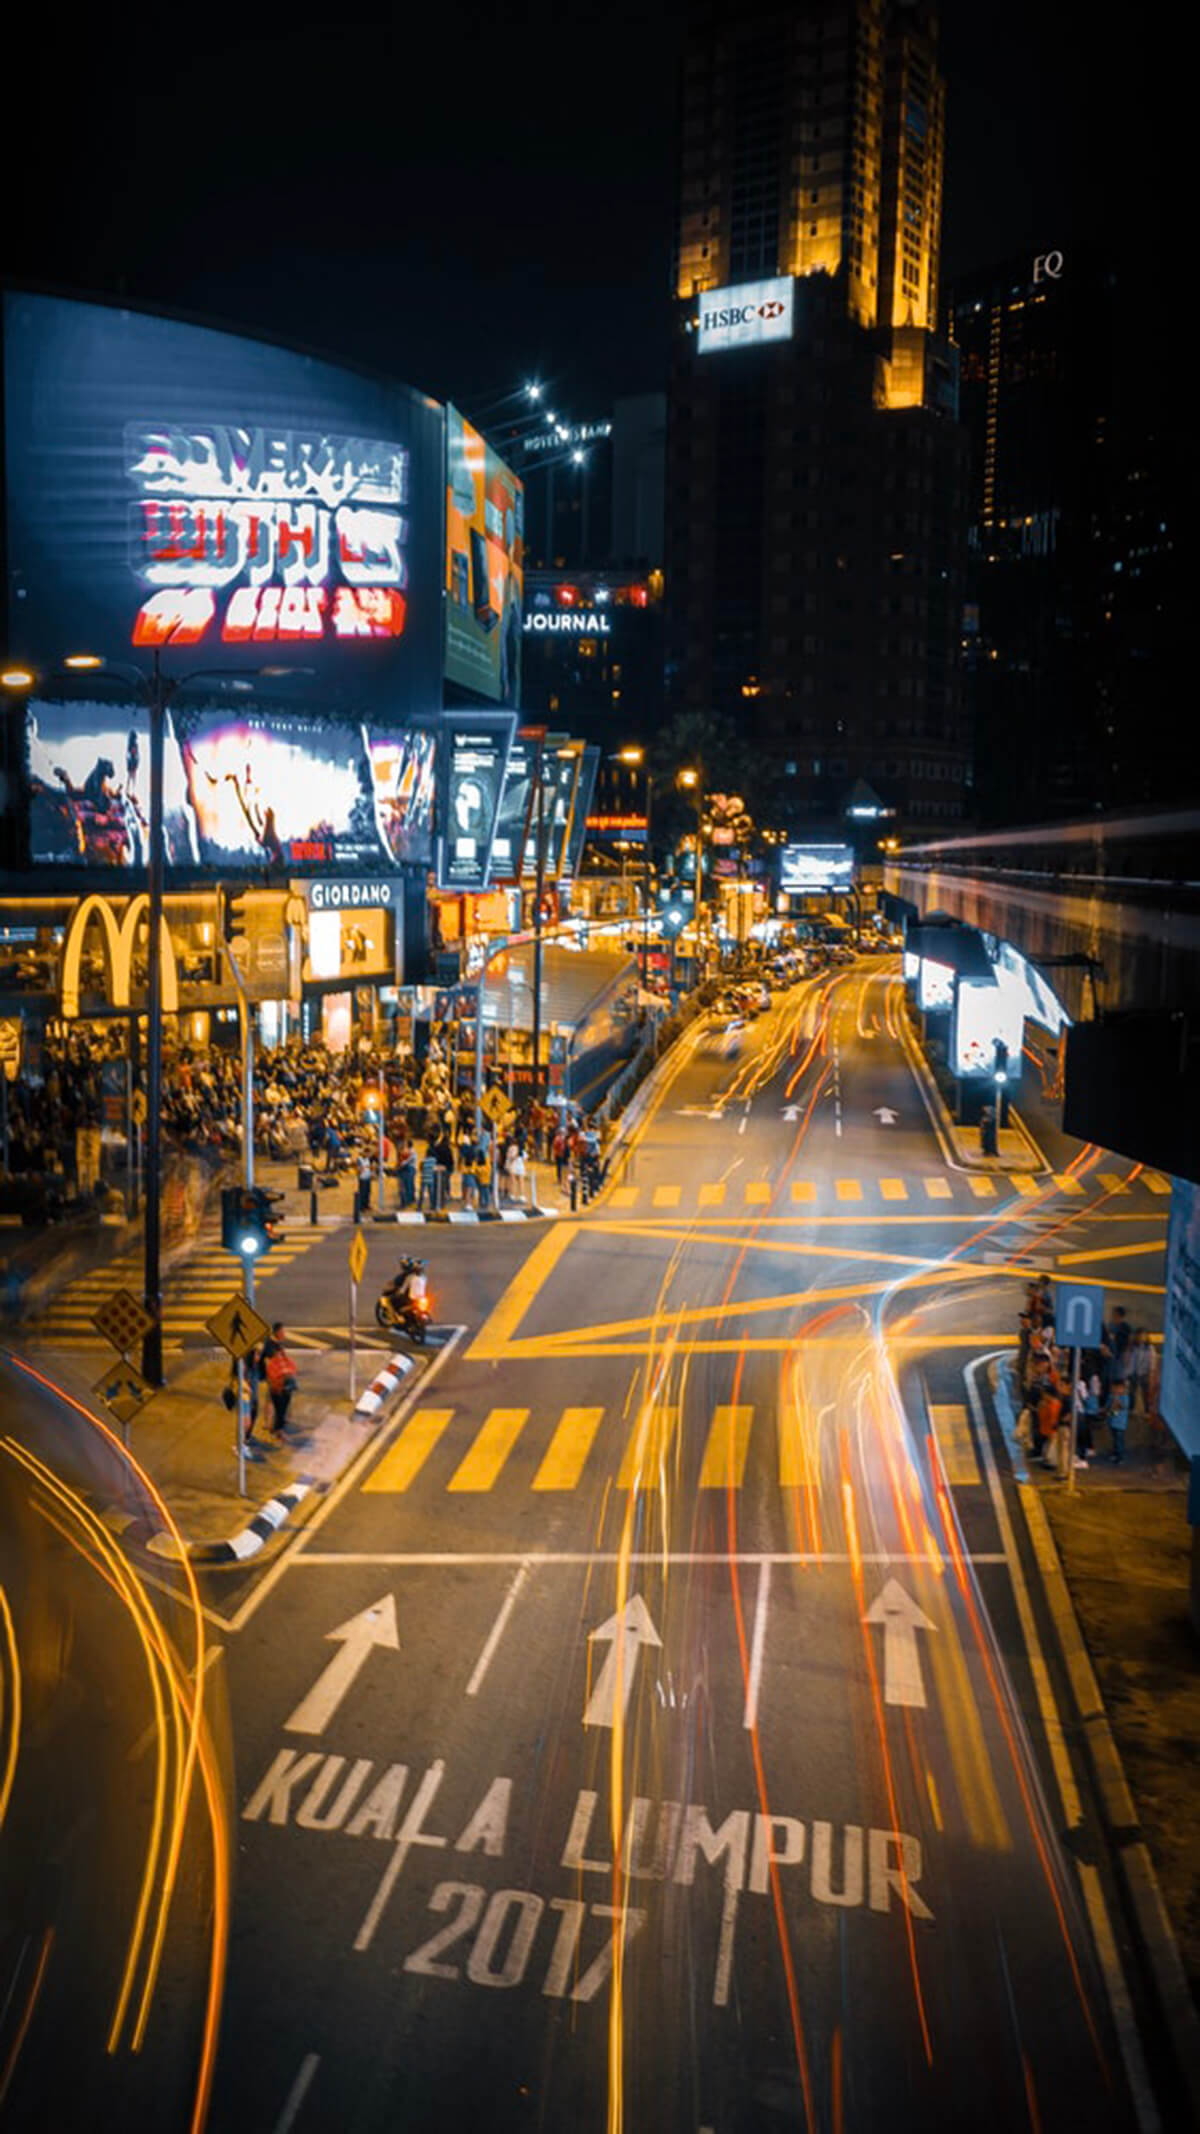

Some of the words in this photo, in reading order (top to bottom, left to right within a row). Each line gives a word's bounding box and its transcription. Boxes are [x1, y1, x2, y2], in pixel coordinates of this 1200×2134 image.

[703, 305, 756, 331] HSBC
[522, 613, 611, 633] JOURNAL
[311, 884, 391, 908] GIORDANO
[241, 1748, 512, 1855] KUALA
[560, 1789, 935, 1919] LUMPUR
[403, 1881, 647, 2003] 2017
